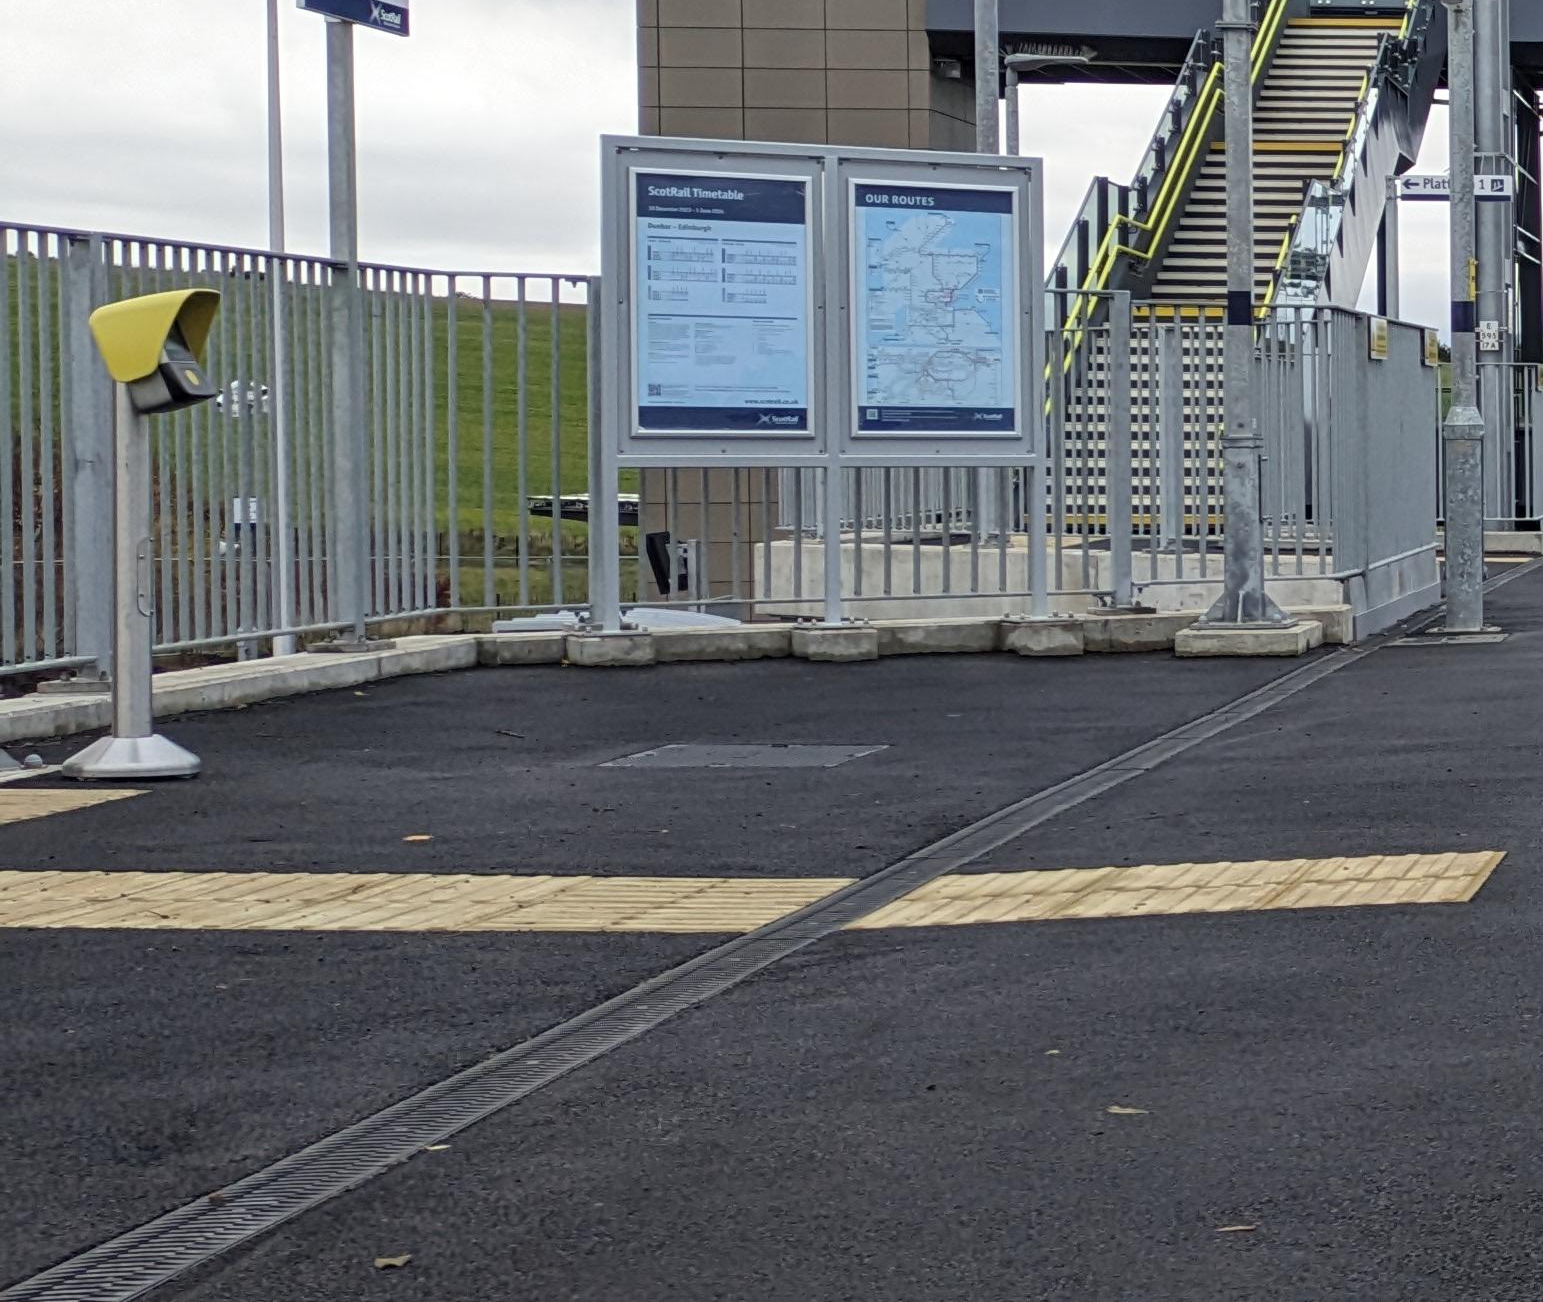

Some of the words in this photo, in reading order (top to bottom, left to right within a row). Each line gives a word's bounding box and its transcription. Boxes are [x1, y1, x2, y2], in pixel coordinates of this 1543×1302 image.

[1479, 179, 1485, 189] 1
[647, 185, 691, 198] ScotRail
[692, 188, 744, 201] Timetable
[865, 193, 889, 204] OUR
[892, 194, 935, 206] ROUTES
